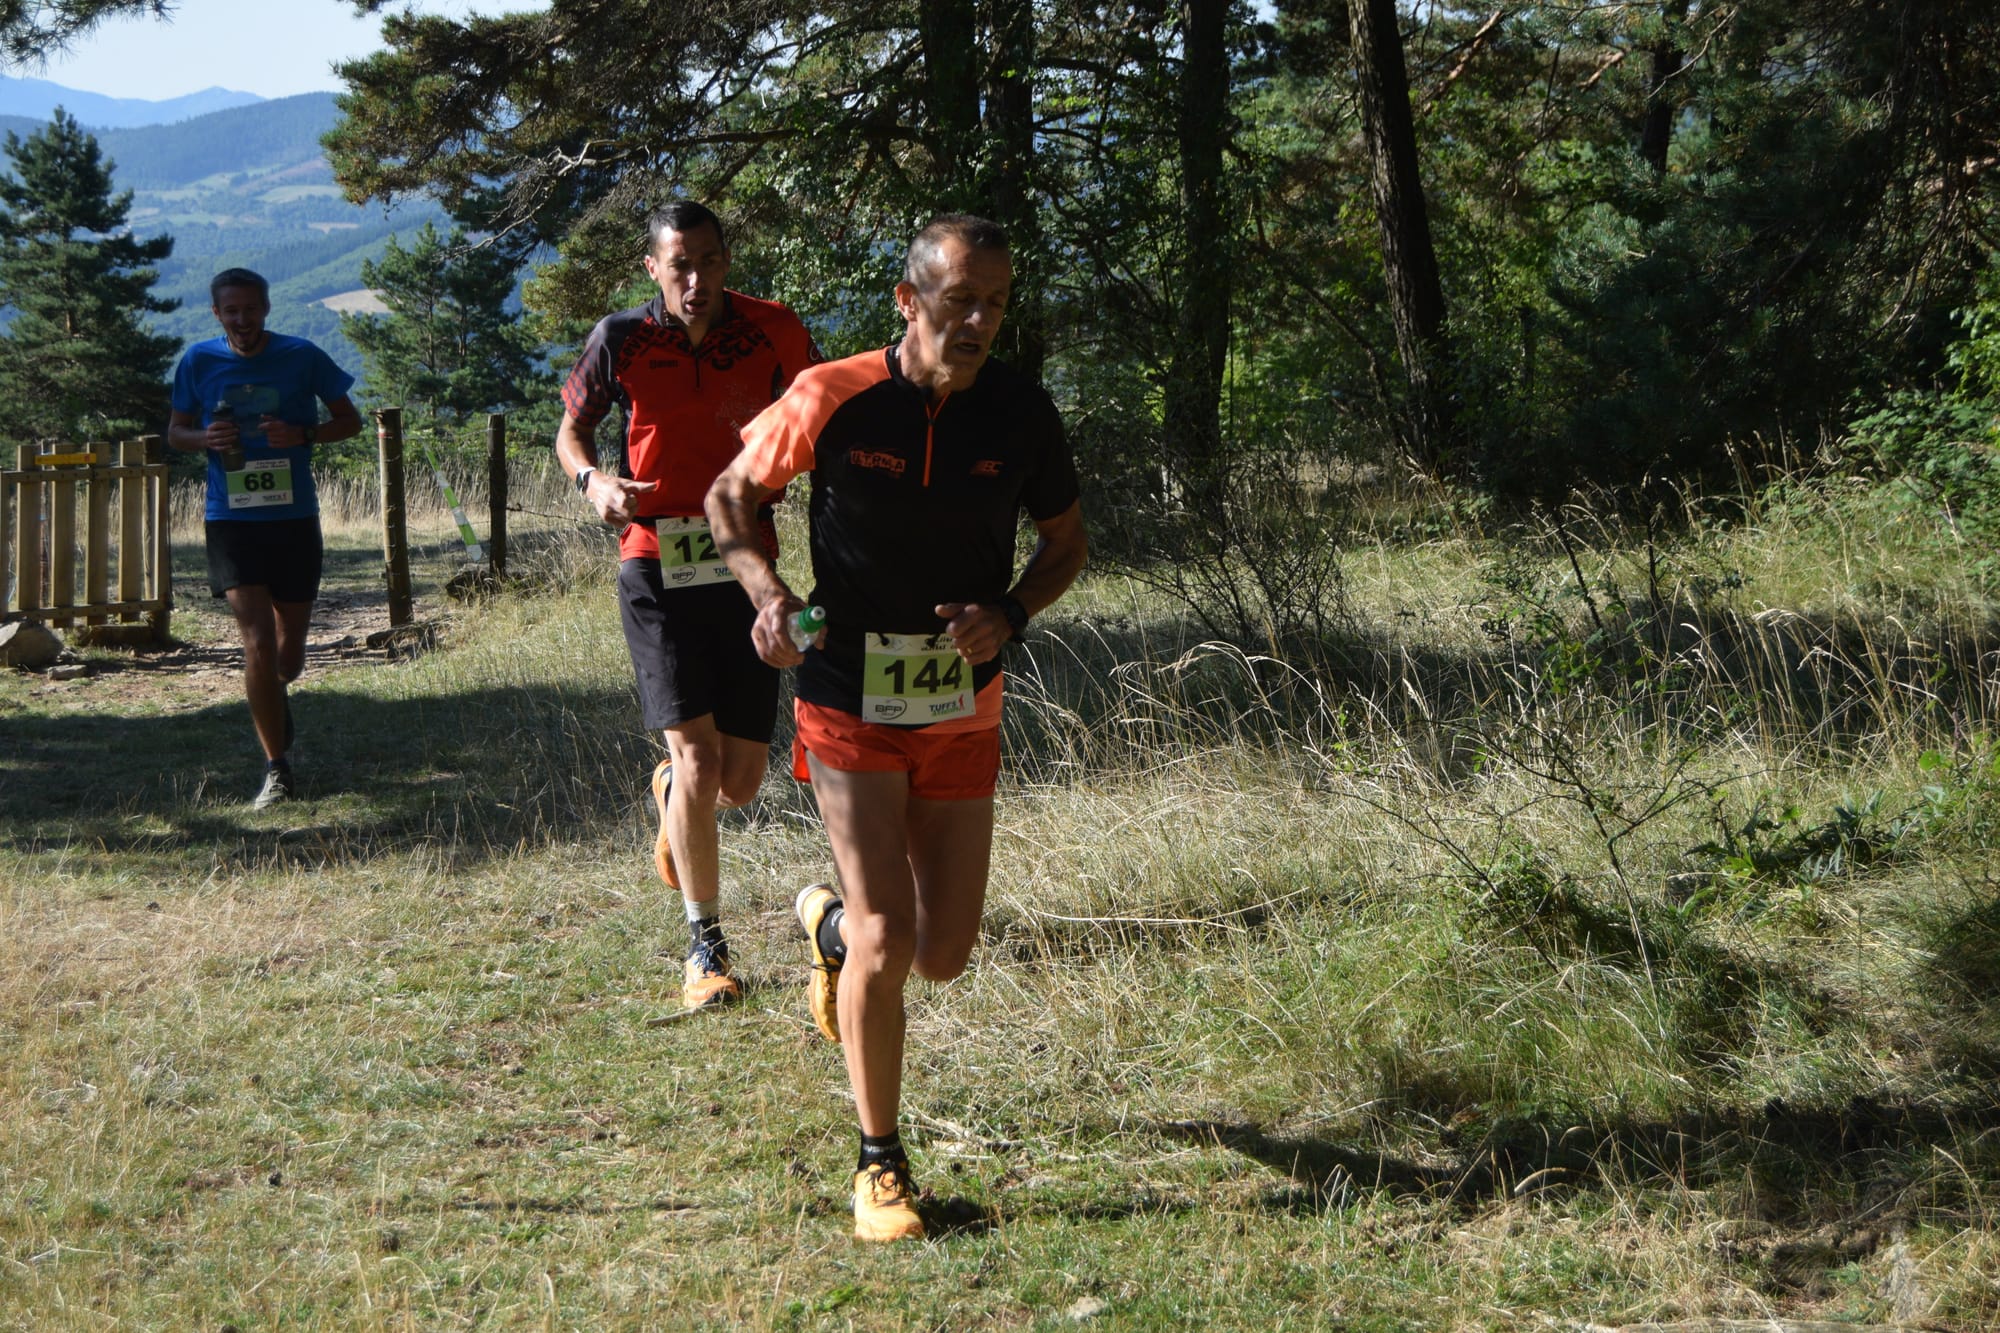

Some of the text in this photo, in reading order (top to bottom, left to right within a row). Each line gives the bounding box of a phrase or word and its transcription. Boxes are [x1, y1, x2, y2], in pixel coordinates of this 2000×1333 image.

[244, 472, 275, 492] 68
[884, 656, 962, 694] 144
[875, 704, 902, 713] BFP
